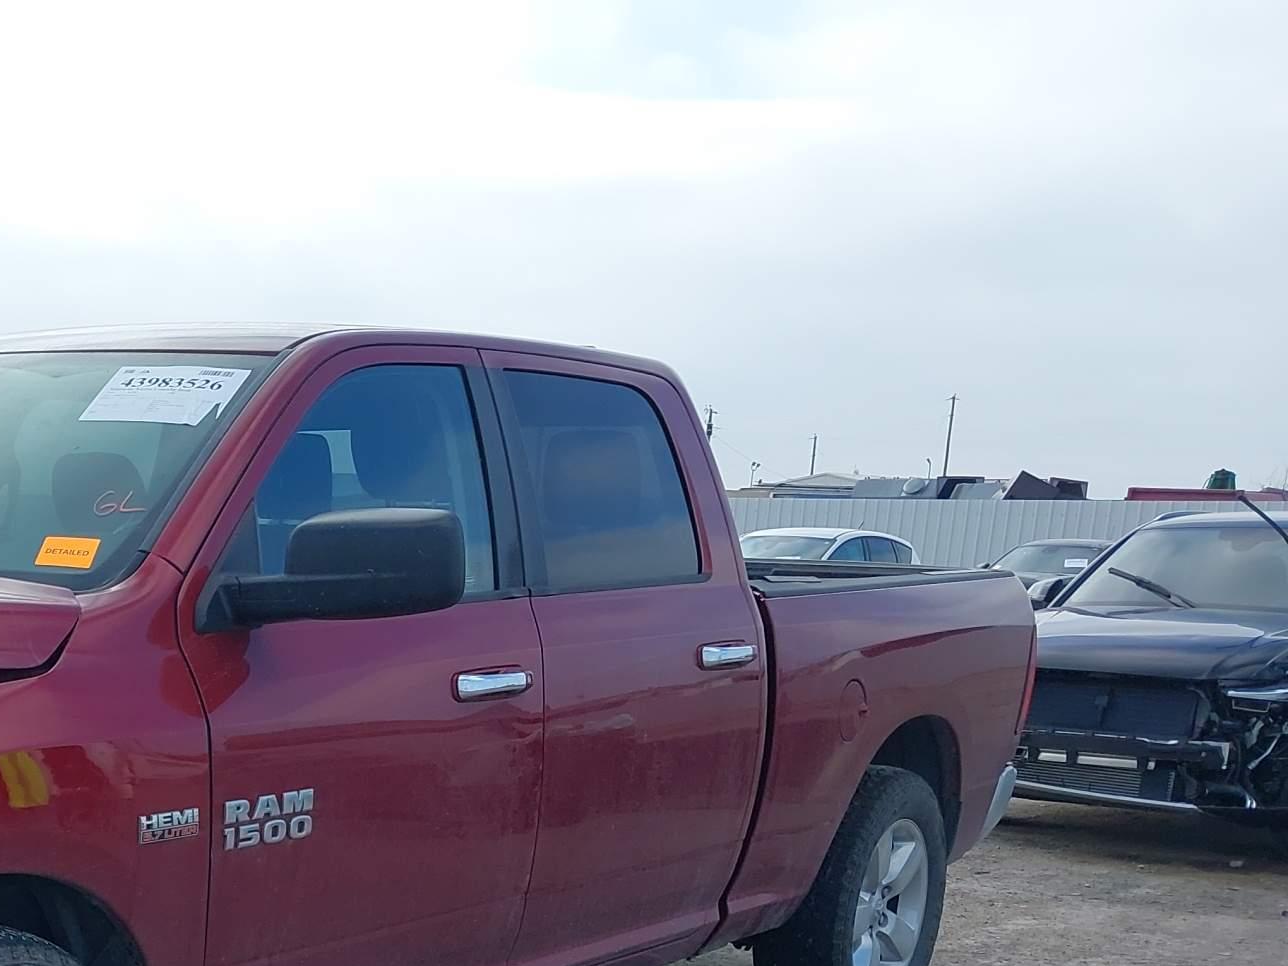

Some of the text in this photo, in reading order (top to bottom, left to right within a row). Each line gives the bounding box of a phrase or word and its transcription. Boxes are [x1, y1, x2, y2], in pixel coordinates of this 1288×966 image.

[120, 376, 225, 392] 43983526
[44, 547, 90, 557] DETAILED
[225, 788, 314, 825] RAM
[139, 808, 199, 830] HEMI
[143, 825, 197, 842] 5.7 LITER
[224, 815, 313, 850] 1500
